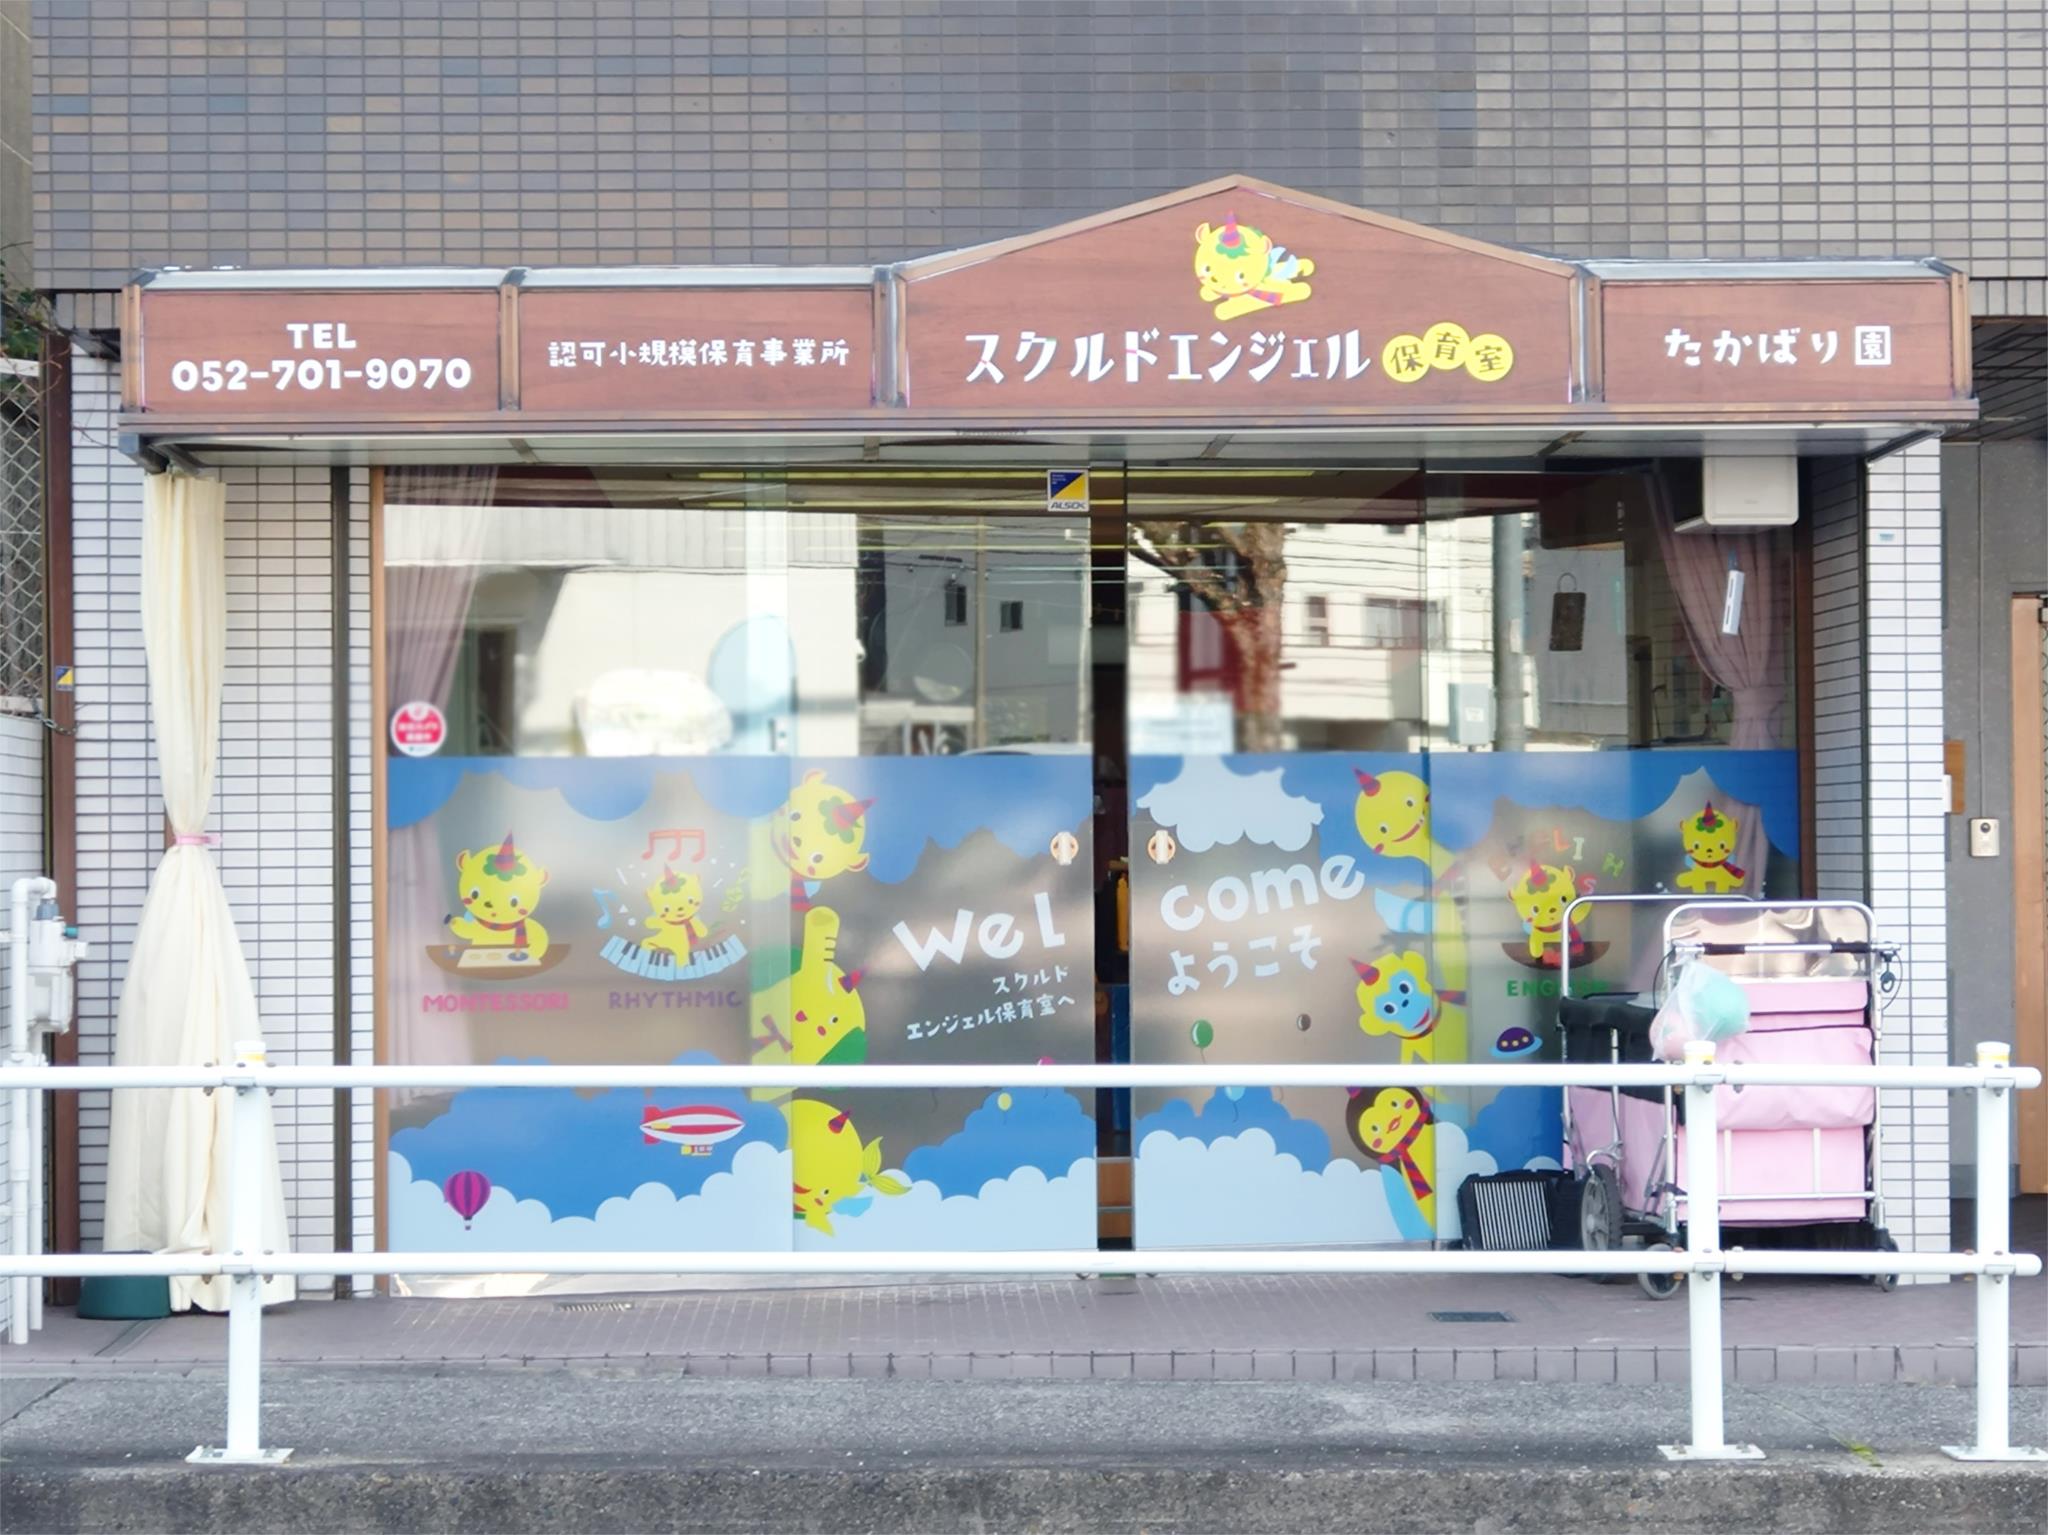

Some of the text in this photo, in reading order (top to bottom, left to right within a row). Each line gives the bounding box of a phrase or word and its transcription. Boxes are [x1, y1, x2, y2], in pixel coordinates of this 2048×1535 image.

[286, 323, 356, 349] TEL
[547, 337, 850, 367] 認可小規模保育事業所
[1664, 325, 1892, 367] たかばり園
[964, 329, 1504, 383] スクルドエンジェル 保育室
[171, 358, 472, 392] 052-701-9070
[1051, 501, 1086, 510] ALSOK
[1160, 854, 1365, 932] come
[1167, 924, 1322, 996] ようこそ
[992, 965, 1069, 994] スクルド
[422, 991, 570, 1013] MONTESSORI
[608, 991, 744, 1009] RHYTHMIC
[906, 994, 1075, 1040] エンジェル保育室へ
